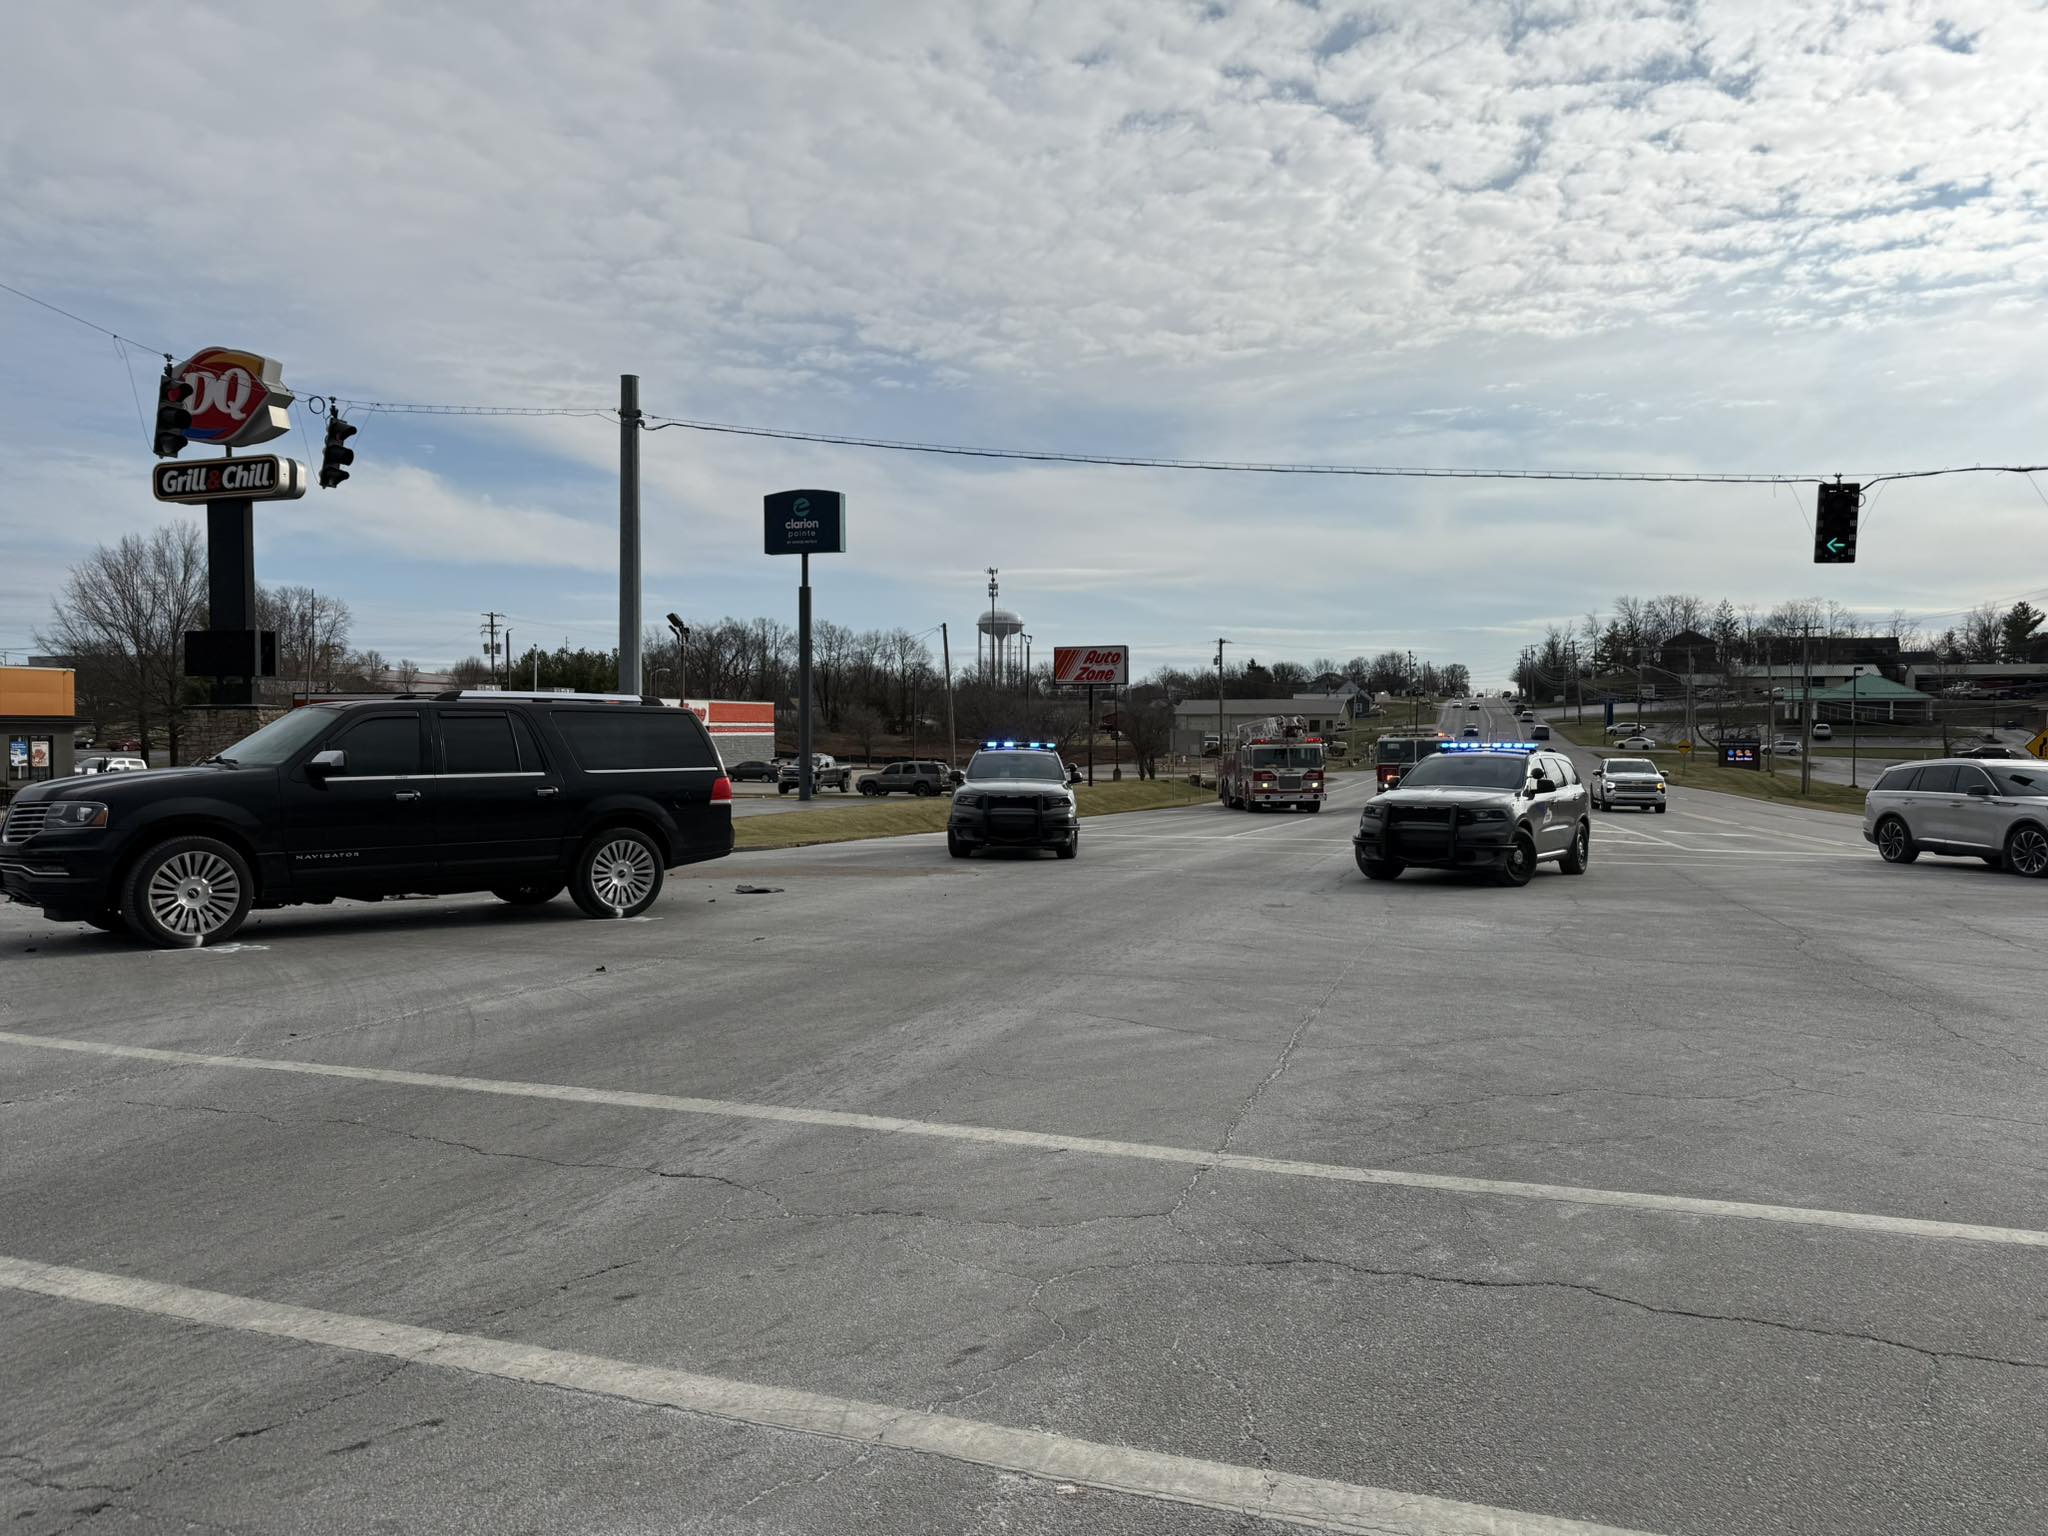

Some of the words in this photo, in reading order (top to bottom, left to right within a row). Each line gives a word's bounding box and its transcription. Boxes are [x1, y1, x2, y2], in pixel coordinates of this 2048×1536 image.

[183, 367, 252, 421] DQ
[162, 467, 207, 493] Grill
[785, 518, 819, 529] clarion
[788, 530, 816, 538] pointe
[1083, 649, 1122, 665] Auto
[1072, 666, 1115, 682] Zone
[295, 852, 359, 860] NAVIGATOR
